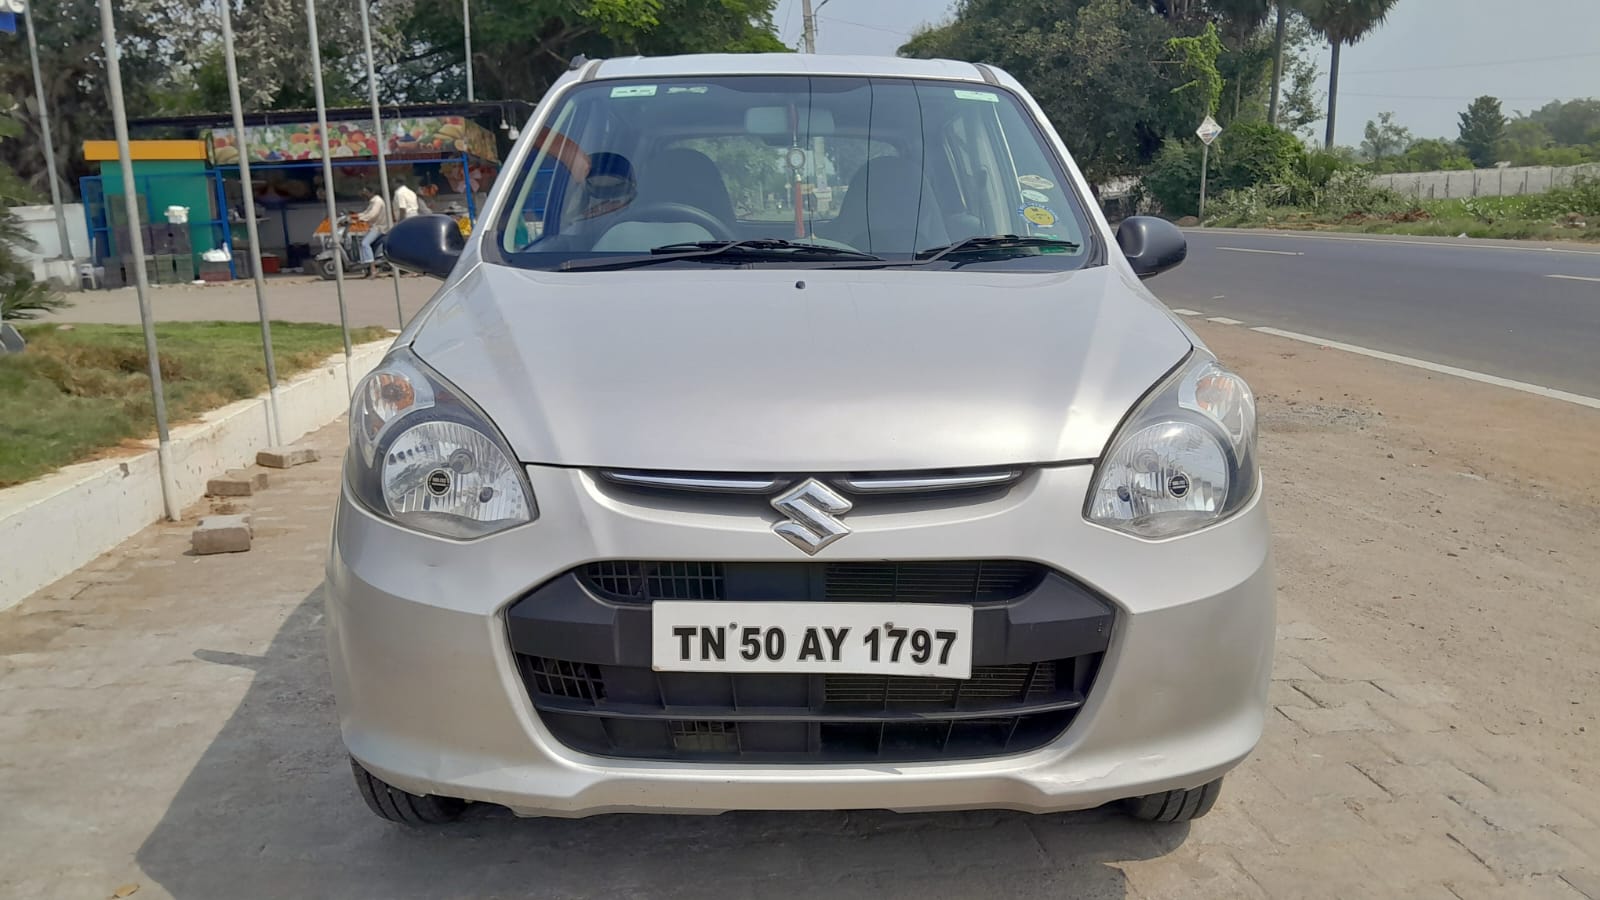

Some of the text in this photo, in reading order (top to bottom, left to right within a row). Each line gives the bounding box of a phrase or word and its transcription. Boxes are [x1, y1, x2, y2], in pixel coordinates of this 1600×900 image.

[672, 626, 958, 666] TN 50 AY 1797
